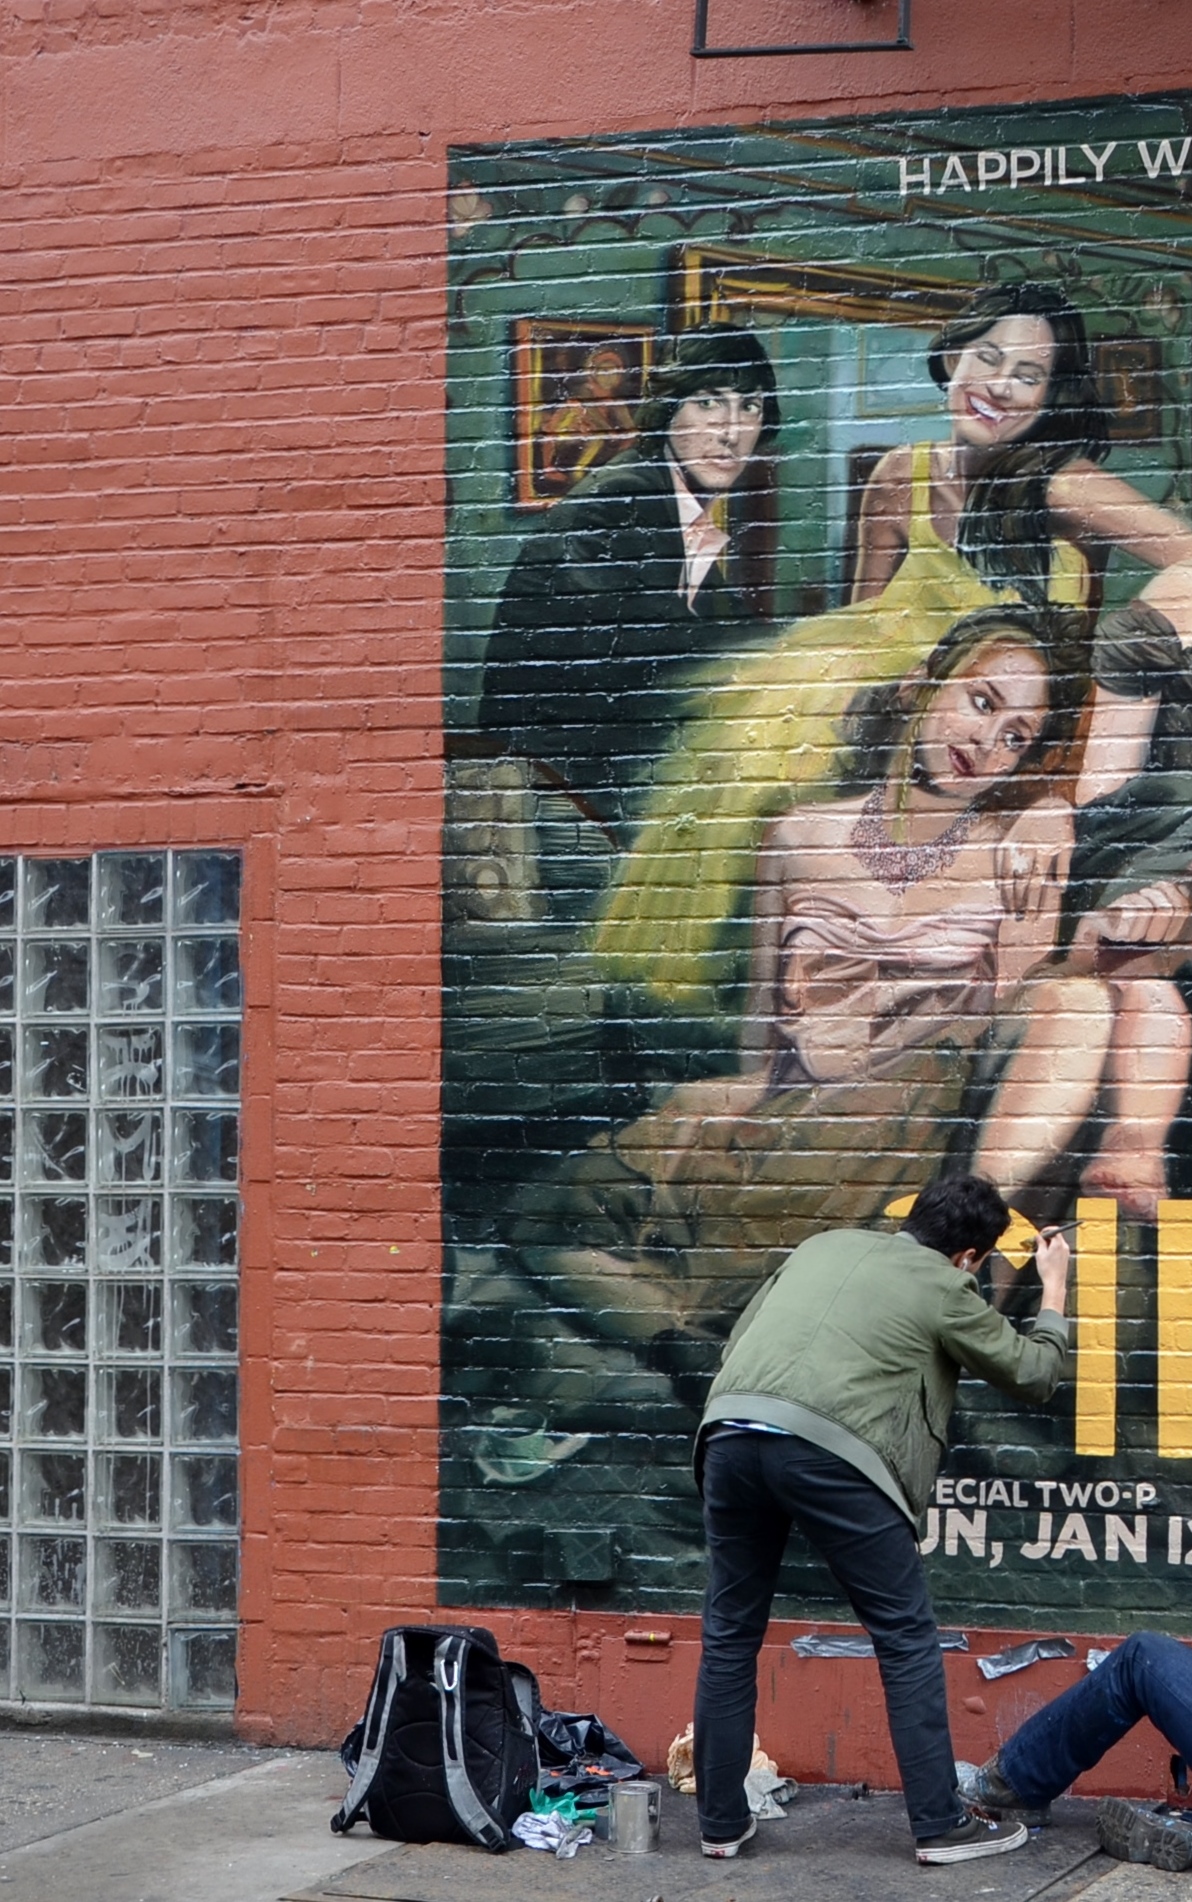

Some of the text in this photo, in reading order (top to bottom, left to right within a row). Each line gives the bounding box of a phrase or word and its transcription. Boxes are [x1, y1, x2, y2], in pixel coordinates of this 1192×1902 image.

[900, 142, 1117, 195] HAPPILY
[930, 1478, 1029, 1508] ECIAL
[916, 1508, 1004, 1568] UN,
[1020, 1512, 1148, 1563] JAN
